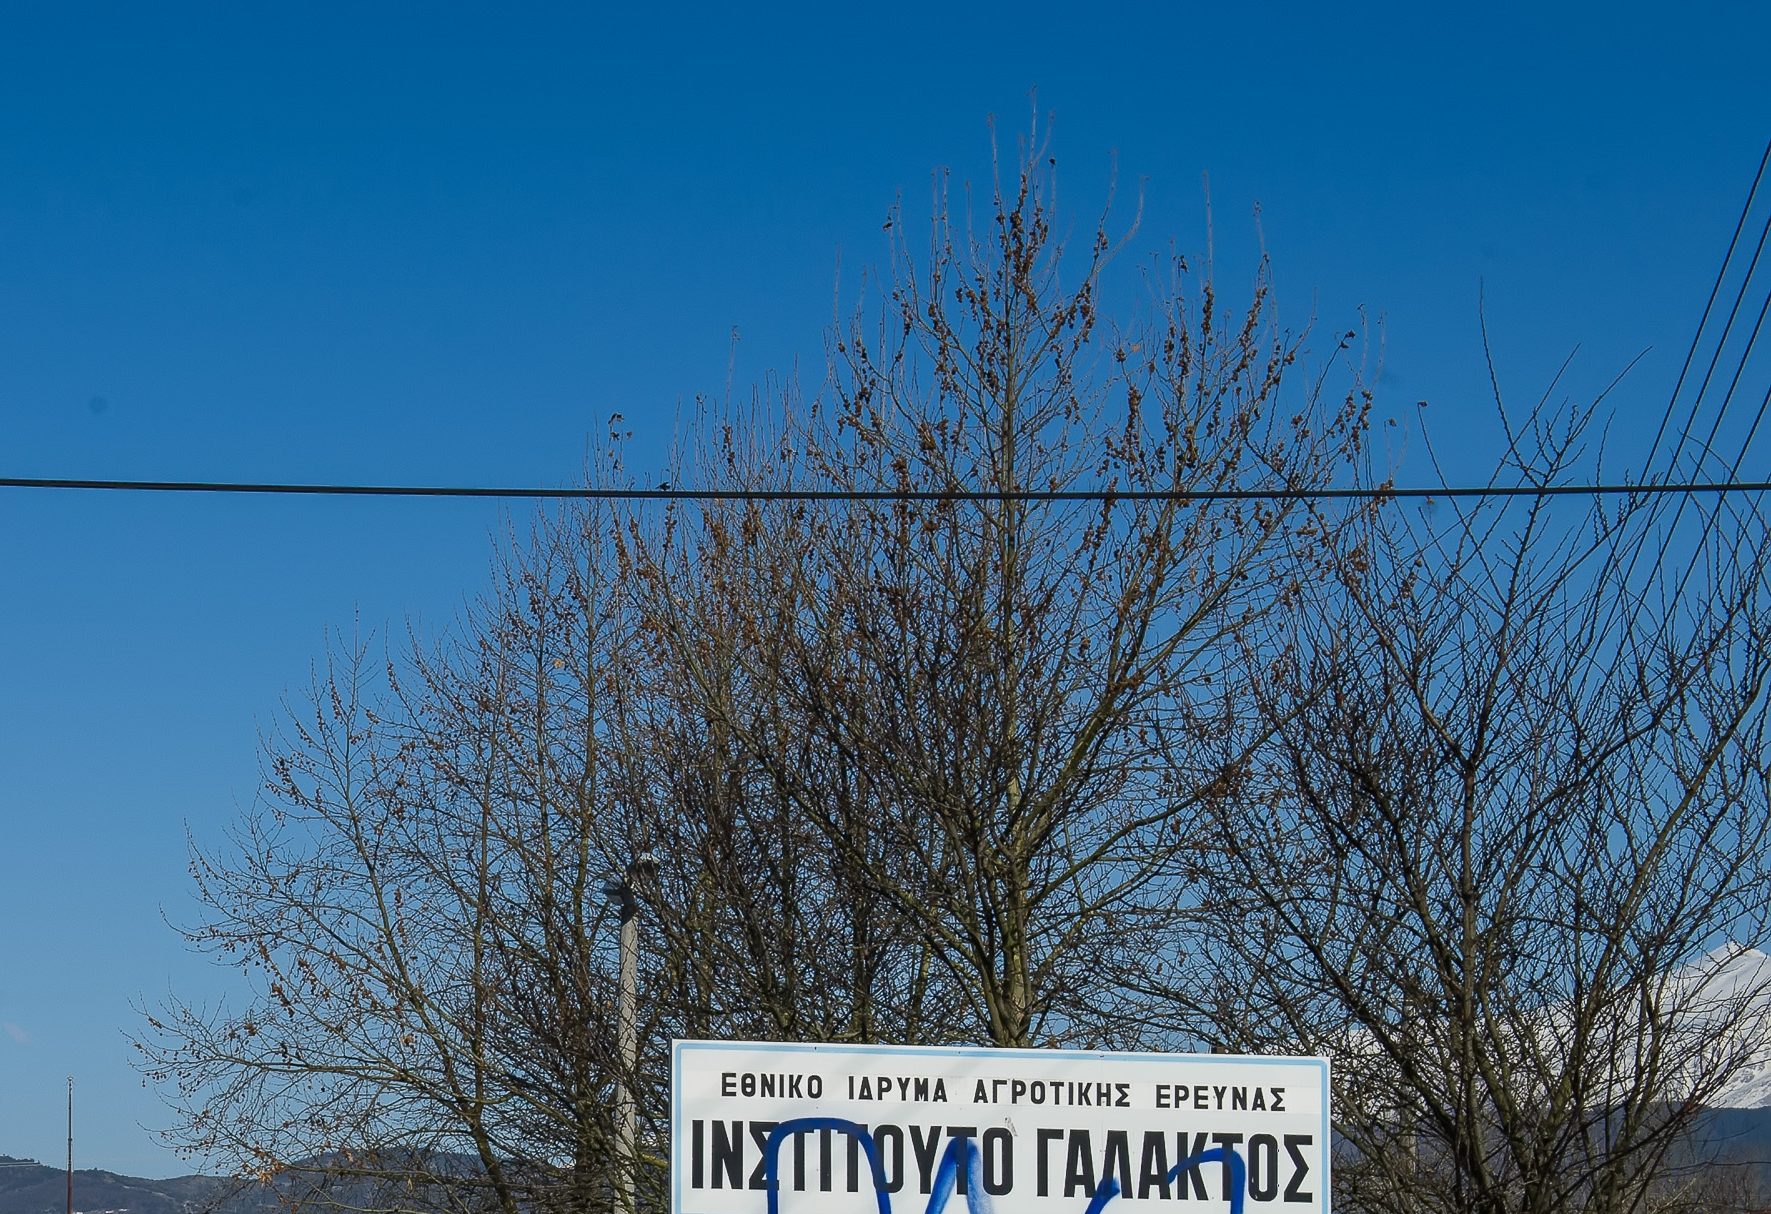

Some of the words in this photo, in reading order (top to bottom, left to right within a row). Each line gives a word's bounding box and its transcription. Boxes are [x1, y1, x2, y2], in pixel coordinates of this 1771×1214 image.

[721, 1072, 823, 1099] ΕΘΝΙΚΟ
[848, 1075, 948, 1103] ΙΔΡΥΜΑ
[974, 1079, 1130, 1108] ΑΓΡΟΤΙΚΗΣ
[1156, 1084, 1286, 1112] ΕΡΕΥΝΑΣ
[691, 1119, 1014, 1196] ΙΝΣΤΙΤΟΥΤΟ
[1036, 1128, 1313, 1204] ΓΑΛΑΚΤΟΣ
